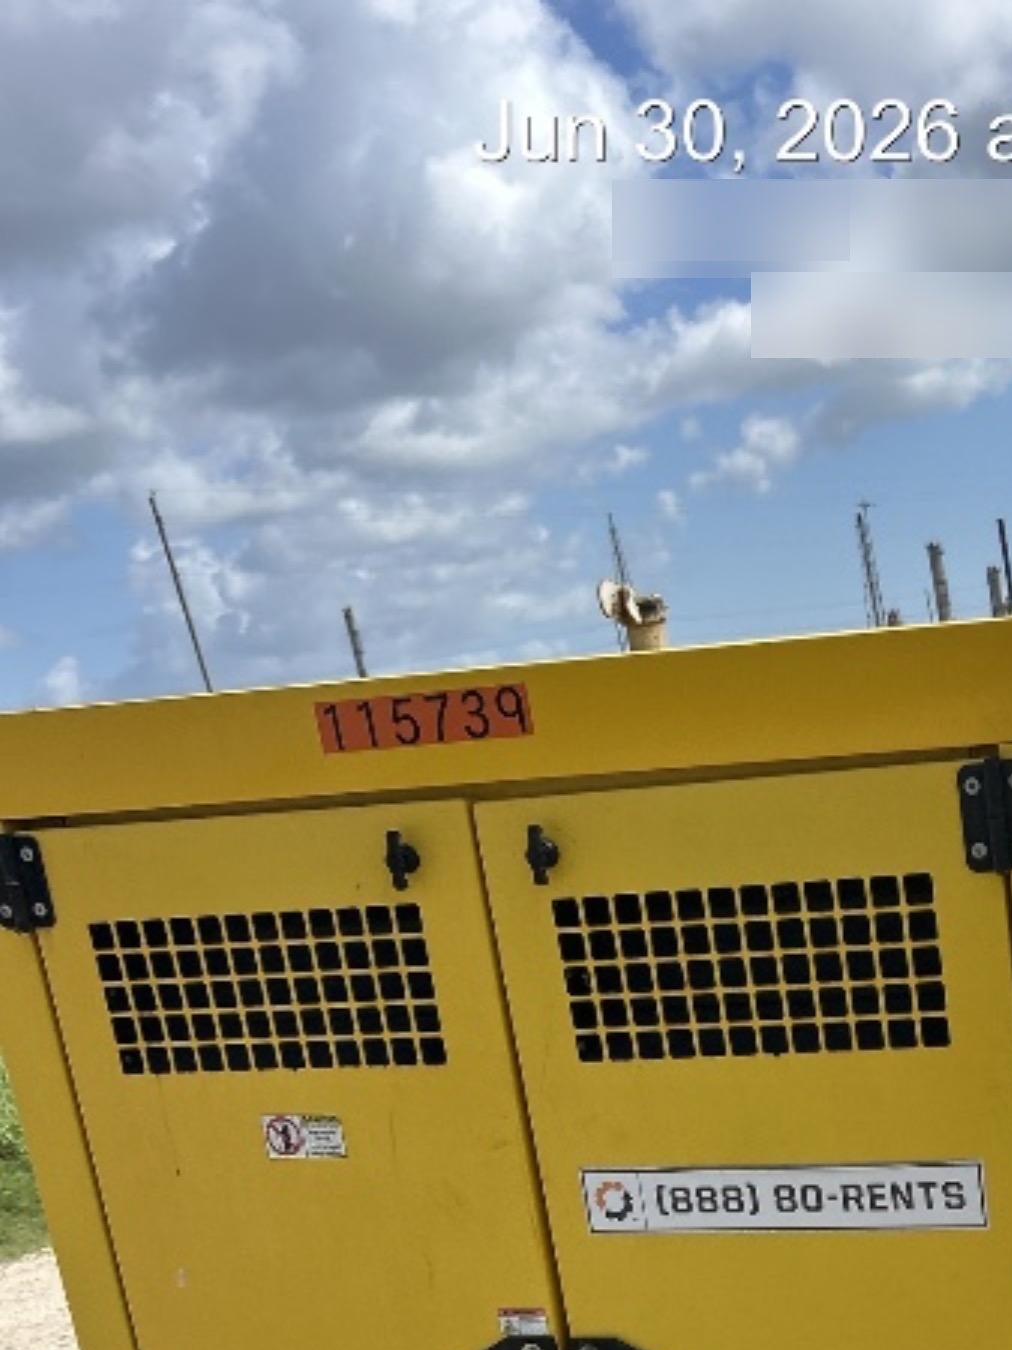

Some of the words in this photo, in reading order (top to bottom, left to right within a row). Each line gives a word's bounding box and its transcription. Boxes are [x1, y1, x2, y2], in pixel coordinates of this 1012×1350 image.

[323, 686, 528, 751] 115739
[656, 1184, 759, 1215] (888)
[773, 1181, 967, 1214] 80-RENTS
